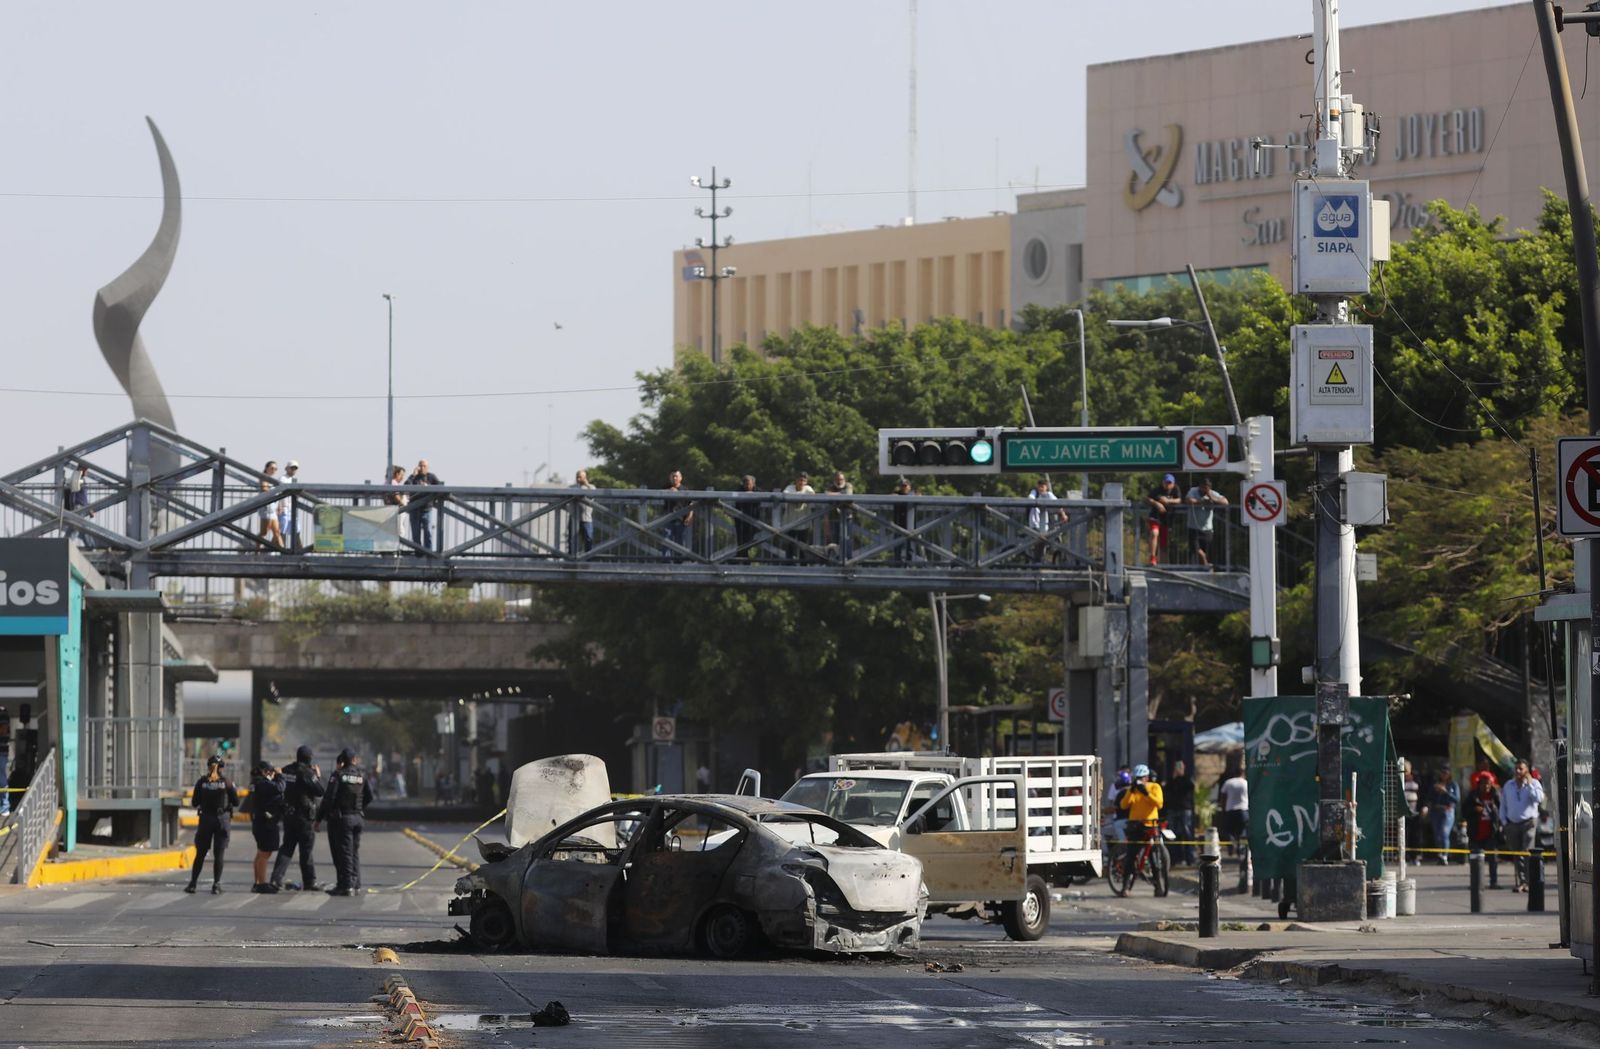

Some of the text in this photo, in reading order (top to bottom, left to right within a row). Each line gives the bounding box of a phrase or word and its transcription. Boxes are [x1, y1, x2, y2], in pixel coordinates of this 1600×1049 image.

[1195, 134, 1276, 185] MAGNO
[1395, 107, 1485, 161] JOYERO
[1320, 212, 1352, 225] agua
[1317, 242, 1354, 253] SIAPA
[1318, 386, 1355, 394] ALTA TENSION
[1019, 443, 1165, 460] AV. JAVIER MINA
